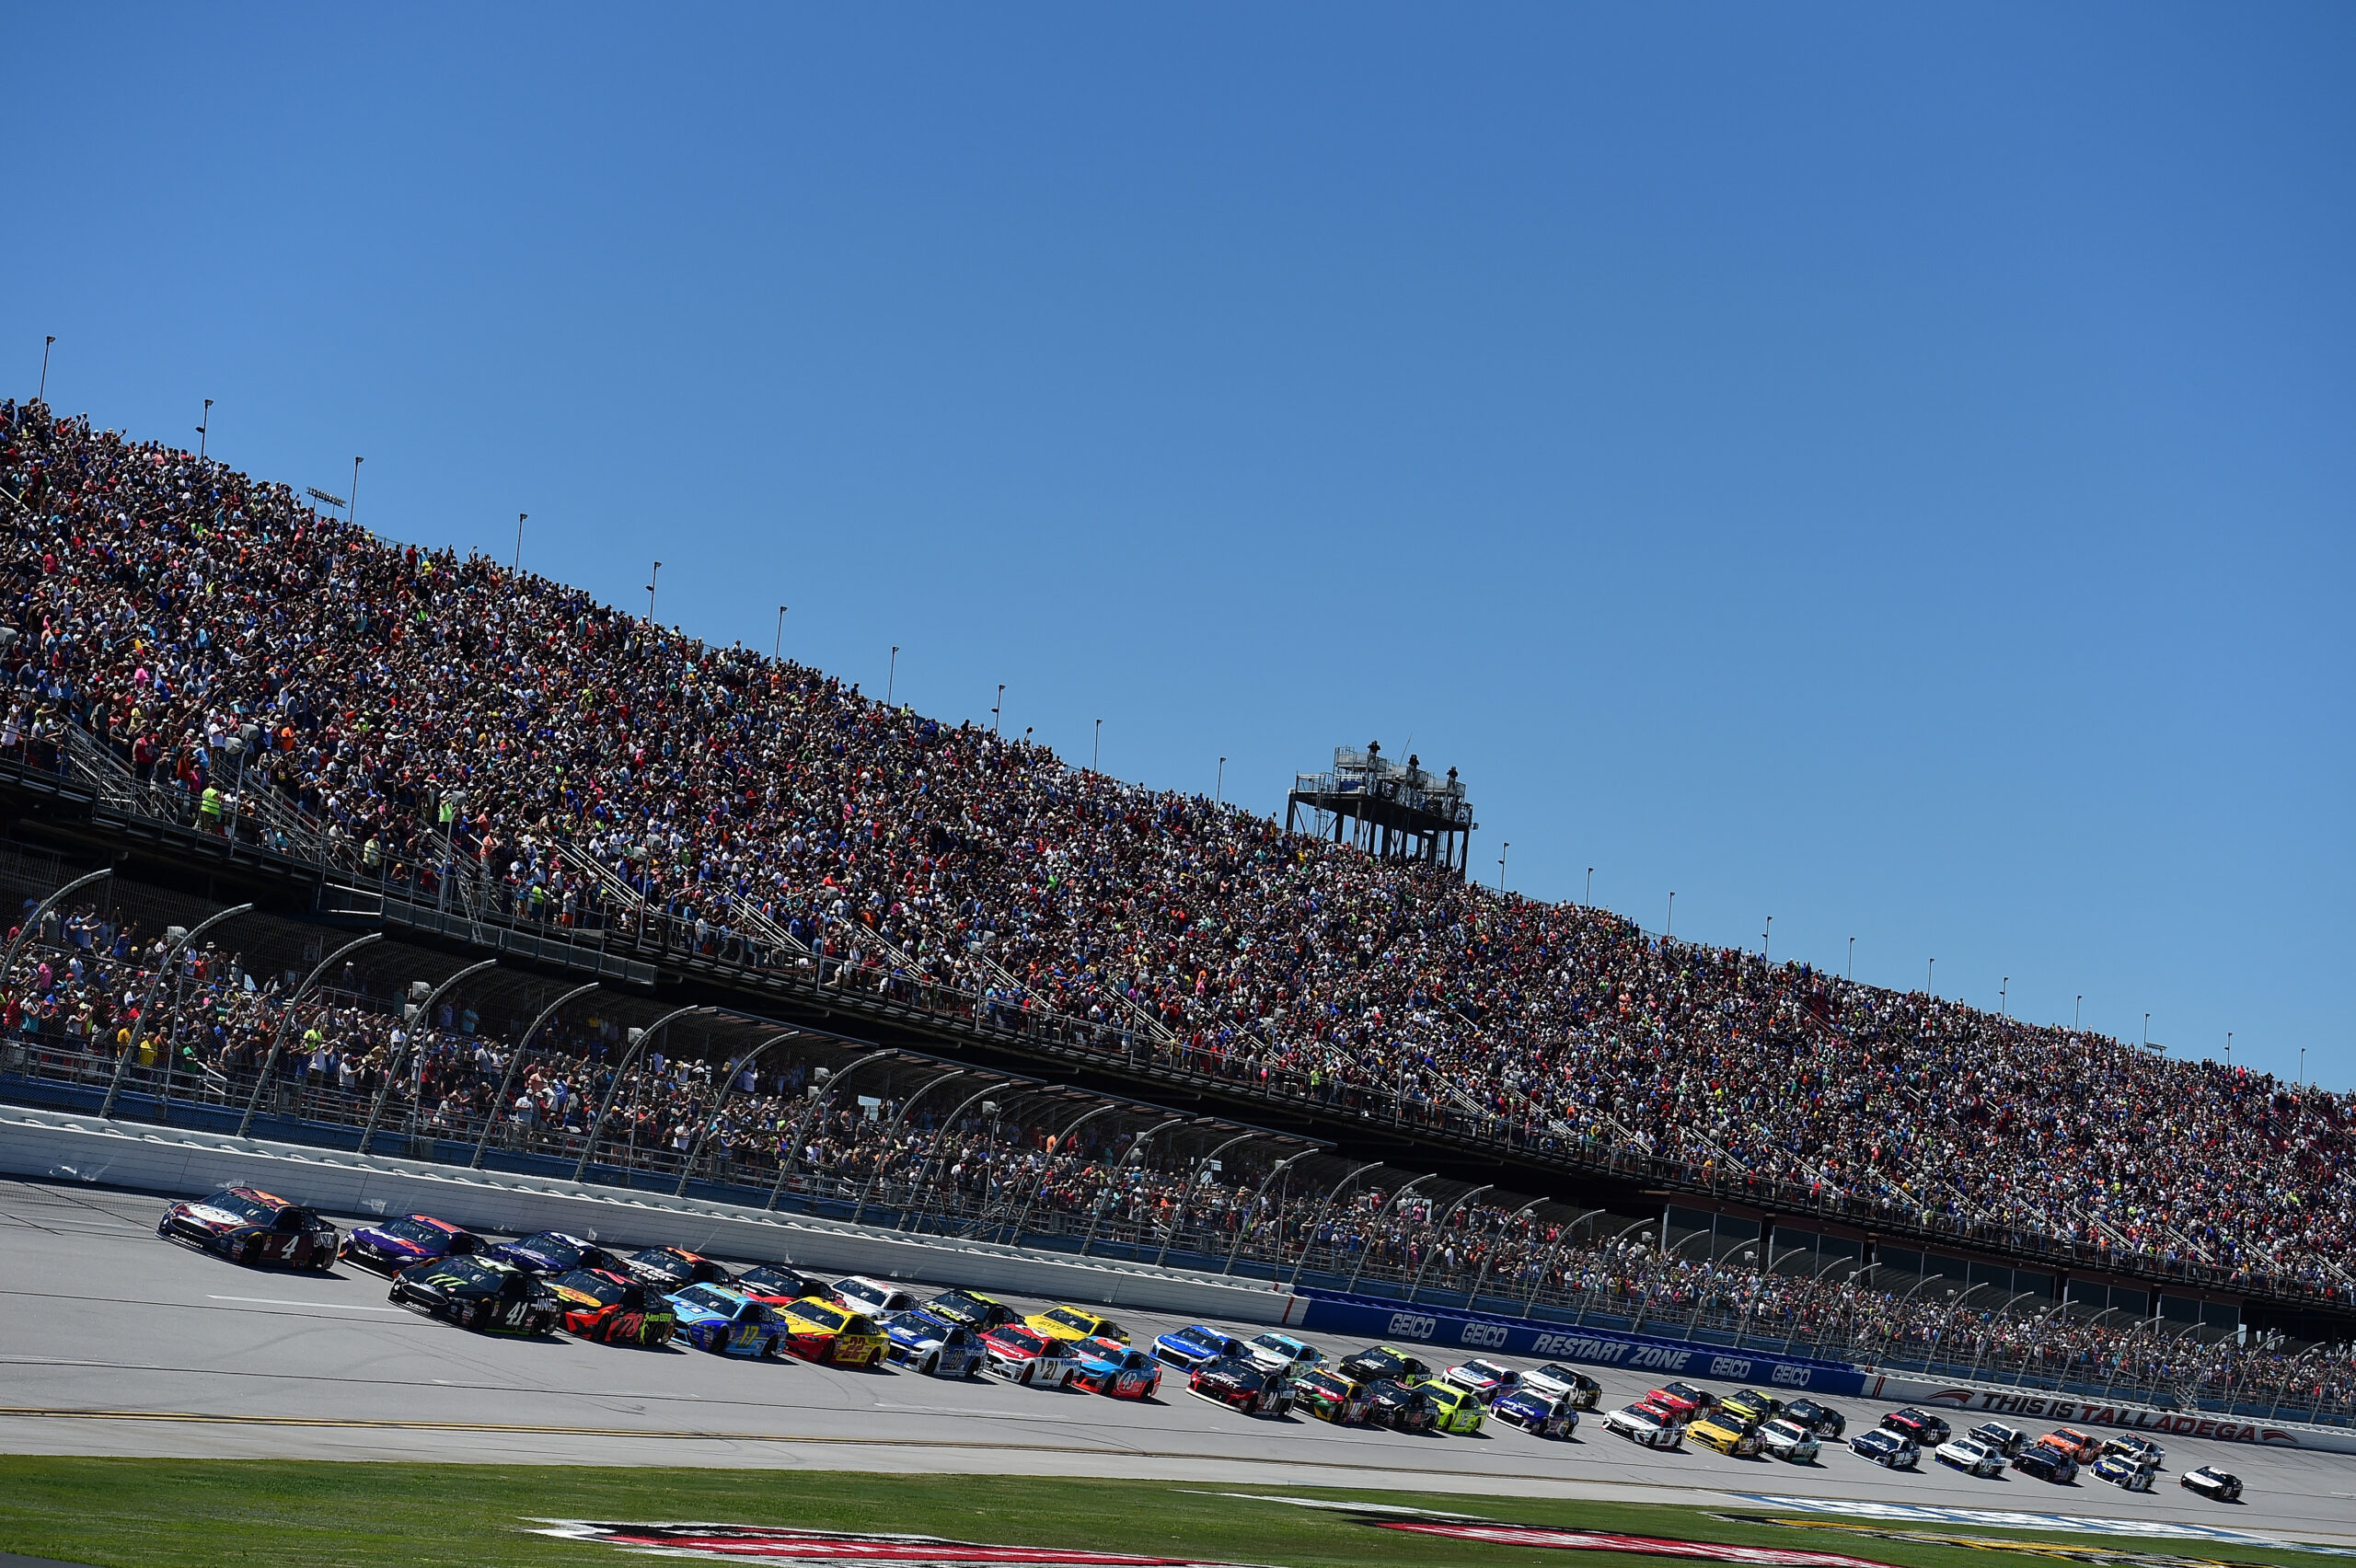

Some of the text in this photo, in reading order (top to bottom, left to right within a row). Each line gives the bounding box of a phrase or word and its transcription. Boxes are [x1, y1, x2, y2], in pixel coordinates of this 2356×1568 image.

[169, 1233, 203, 1249] FUSION
[281, 1235, 300, 1260] 4
[405, 1300, 432, 1314] FUSION
[505, 1301, 529, 1326] 41
[616, 1312, 644, 1337] 78
[738, 1324, 759, 1346] 17
[1387, 1313, 1437, 1339] GEICO
[1461, 1322, 1508, 1348] GEICO
[842, 1337, 867, 1359] 22
[1531, 1333, 1692, 1370] RESTART ZONE
[1042, 1360, 1058, 1380] 21
[1710, 1356, 1751, 1379] GEICO
[1771, 1365, 1812, 1386] GEICO
[1122, 1372, 1138, 1390] 43
[1264, 1391, 1278, 1410] 24
[1981, 1392, 2048, 1414] THIS
[2046, 1401, 2077, 1419] IS
[2080, 1405, 2256, 1441] TALLADEGA
